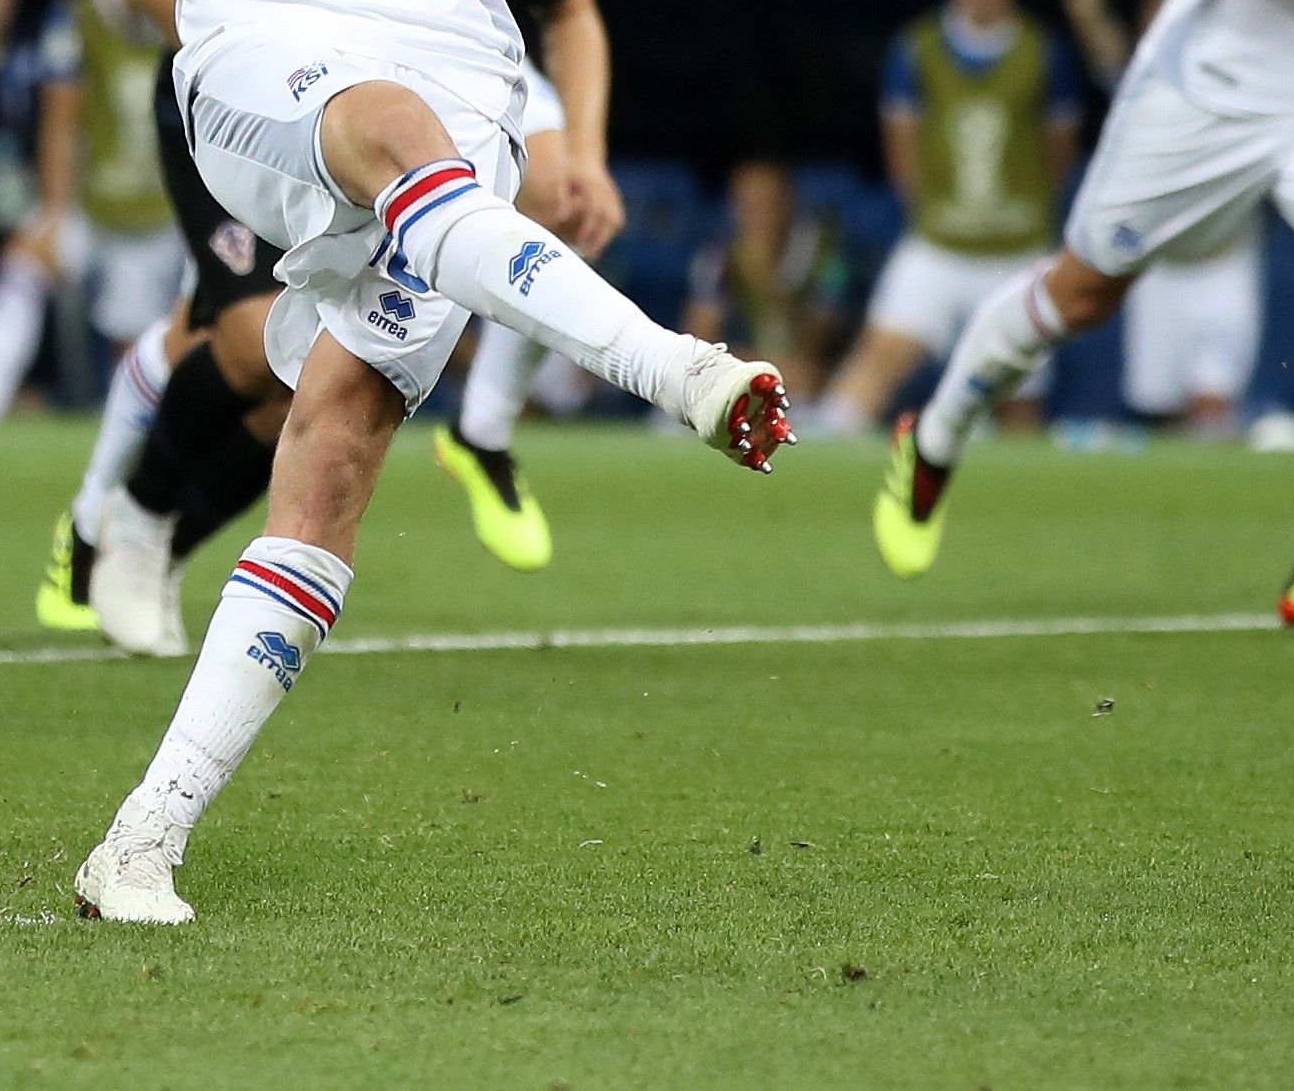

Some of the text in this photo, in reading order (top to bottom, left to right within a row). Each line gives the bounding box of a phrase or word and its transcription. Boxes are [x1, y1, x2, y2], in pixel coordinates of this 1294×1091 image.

[519, 249, 562, 297] errea
[367, 310, 408, 341] errea
[247, 645, 293, 693] errea
